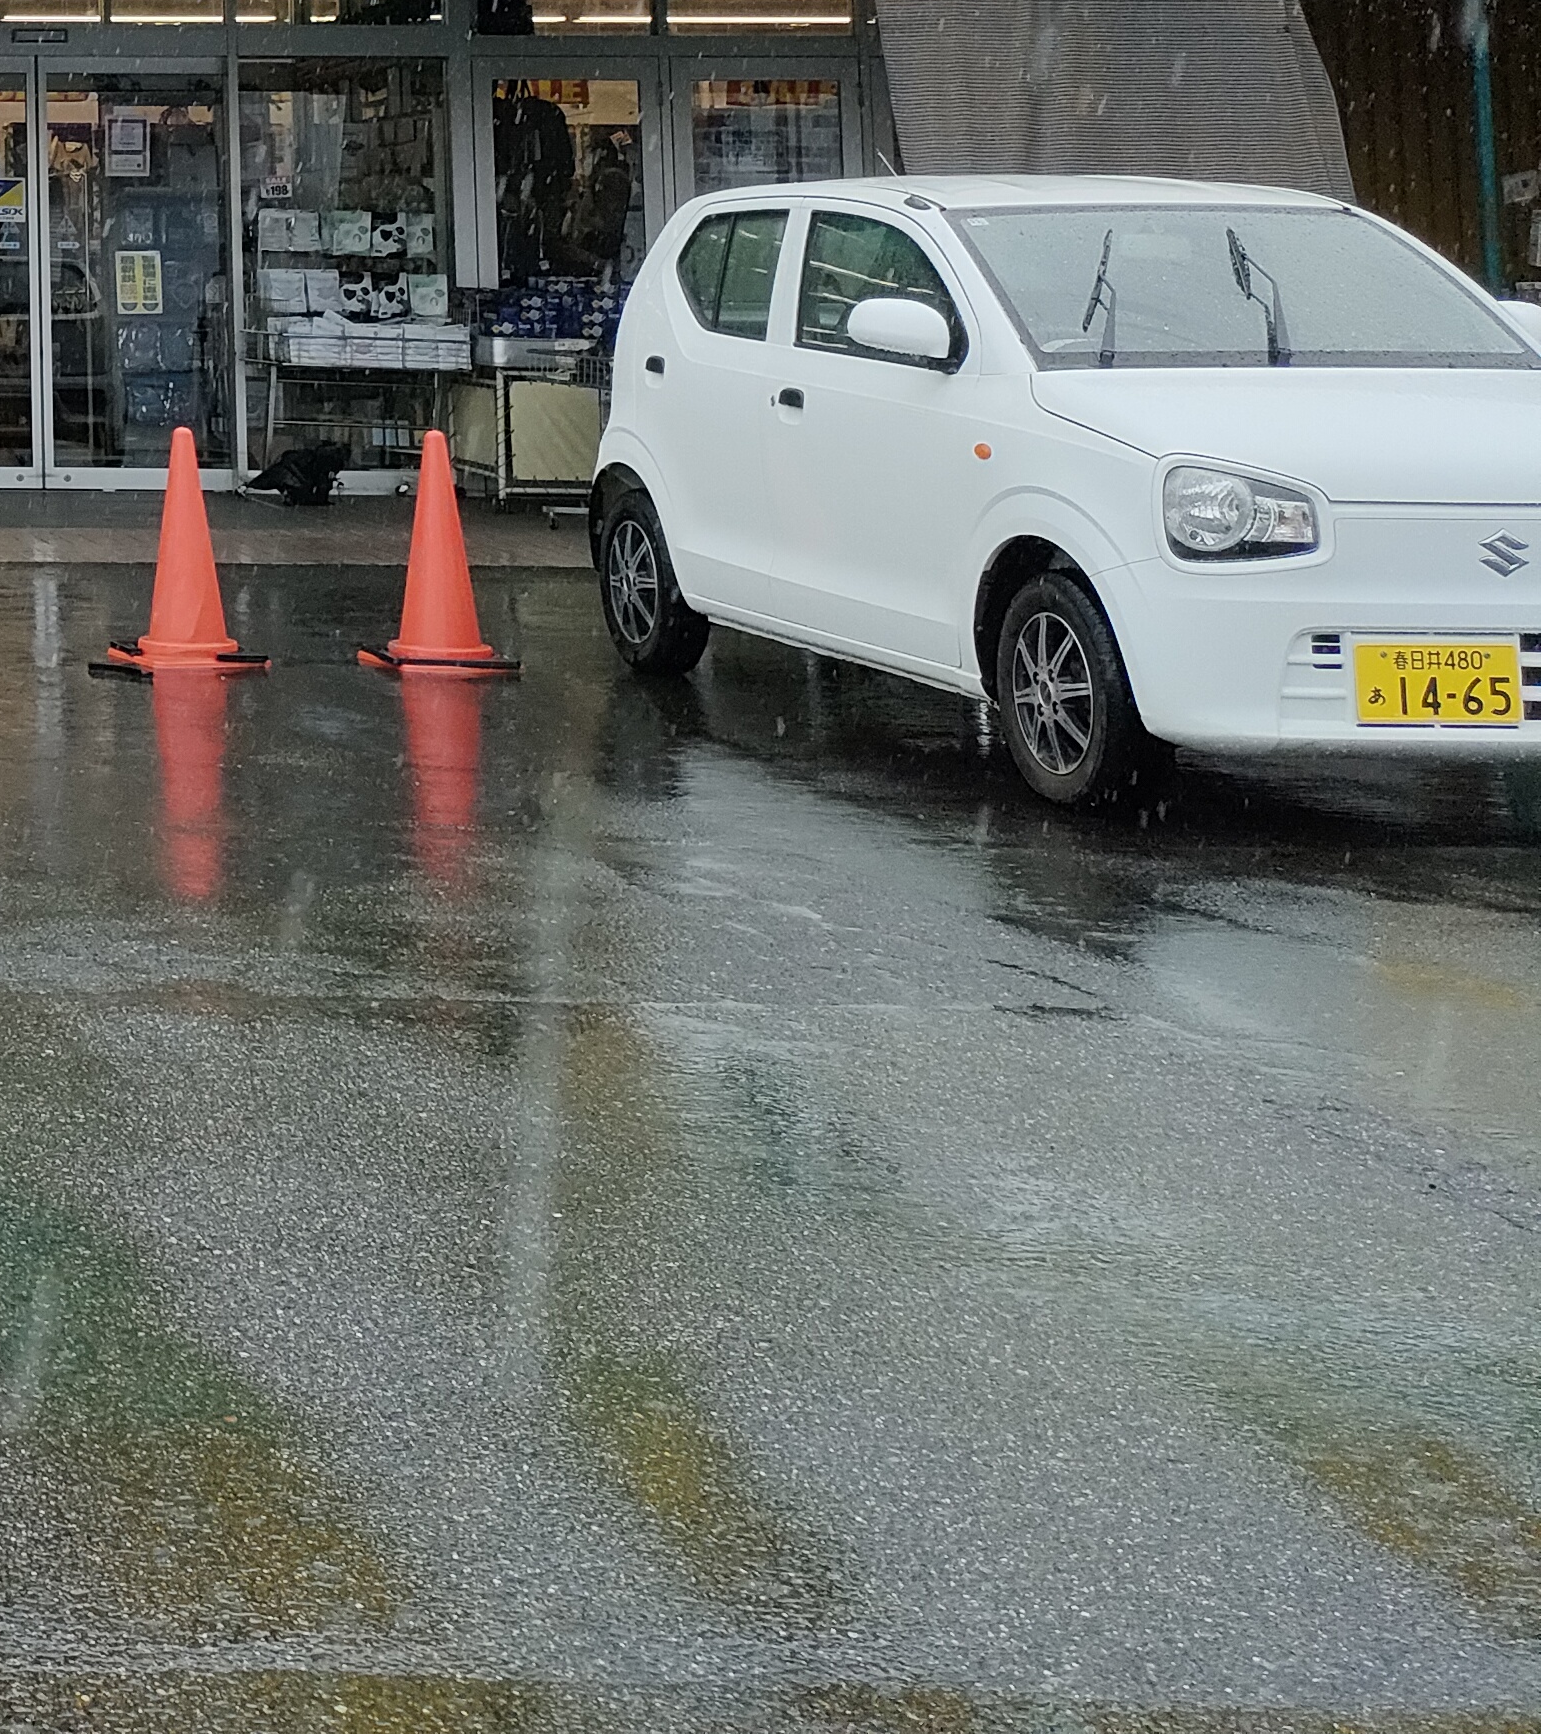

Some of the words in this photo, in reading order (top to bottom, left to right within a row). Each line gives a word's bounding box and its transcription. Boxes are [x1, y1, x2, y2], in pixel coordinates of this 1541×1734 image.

[1393, 650, 1483, 670] 春日井480
[1368, 686, 1386, 706] あ
[1399, 676, 1512, 716] 14-65
